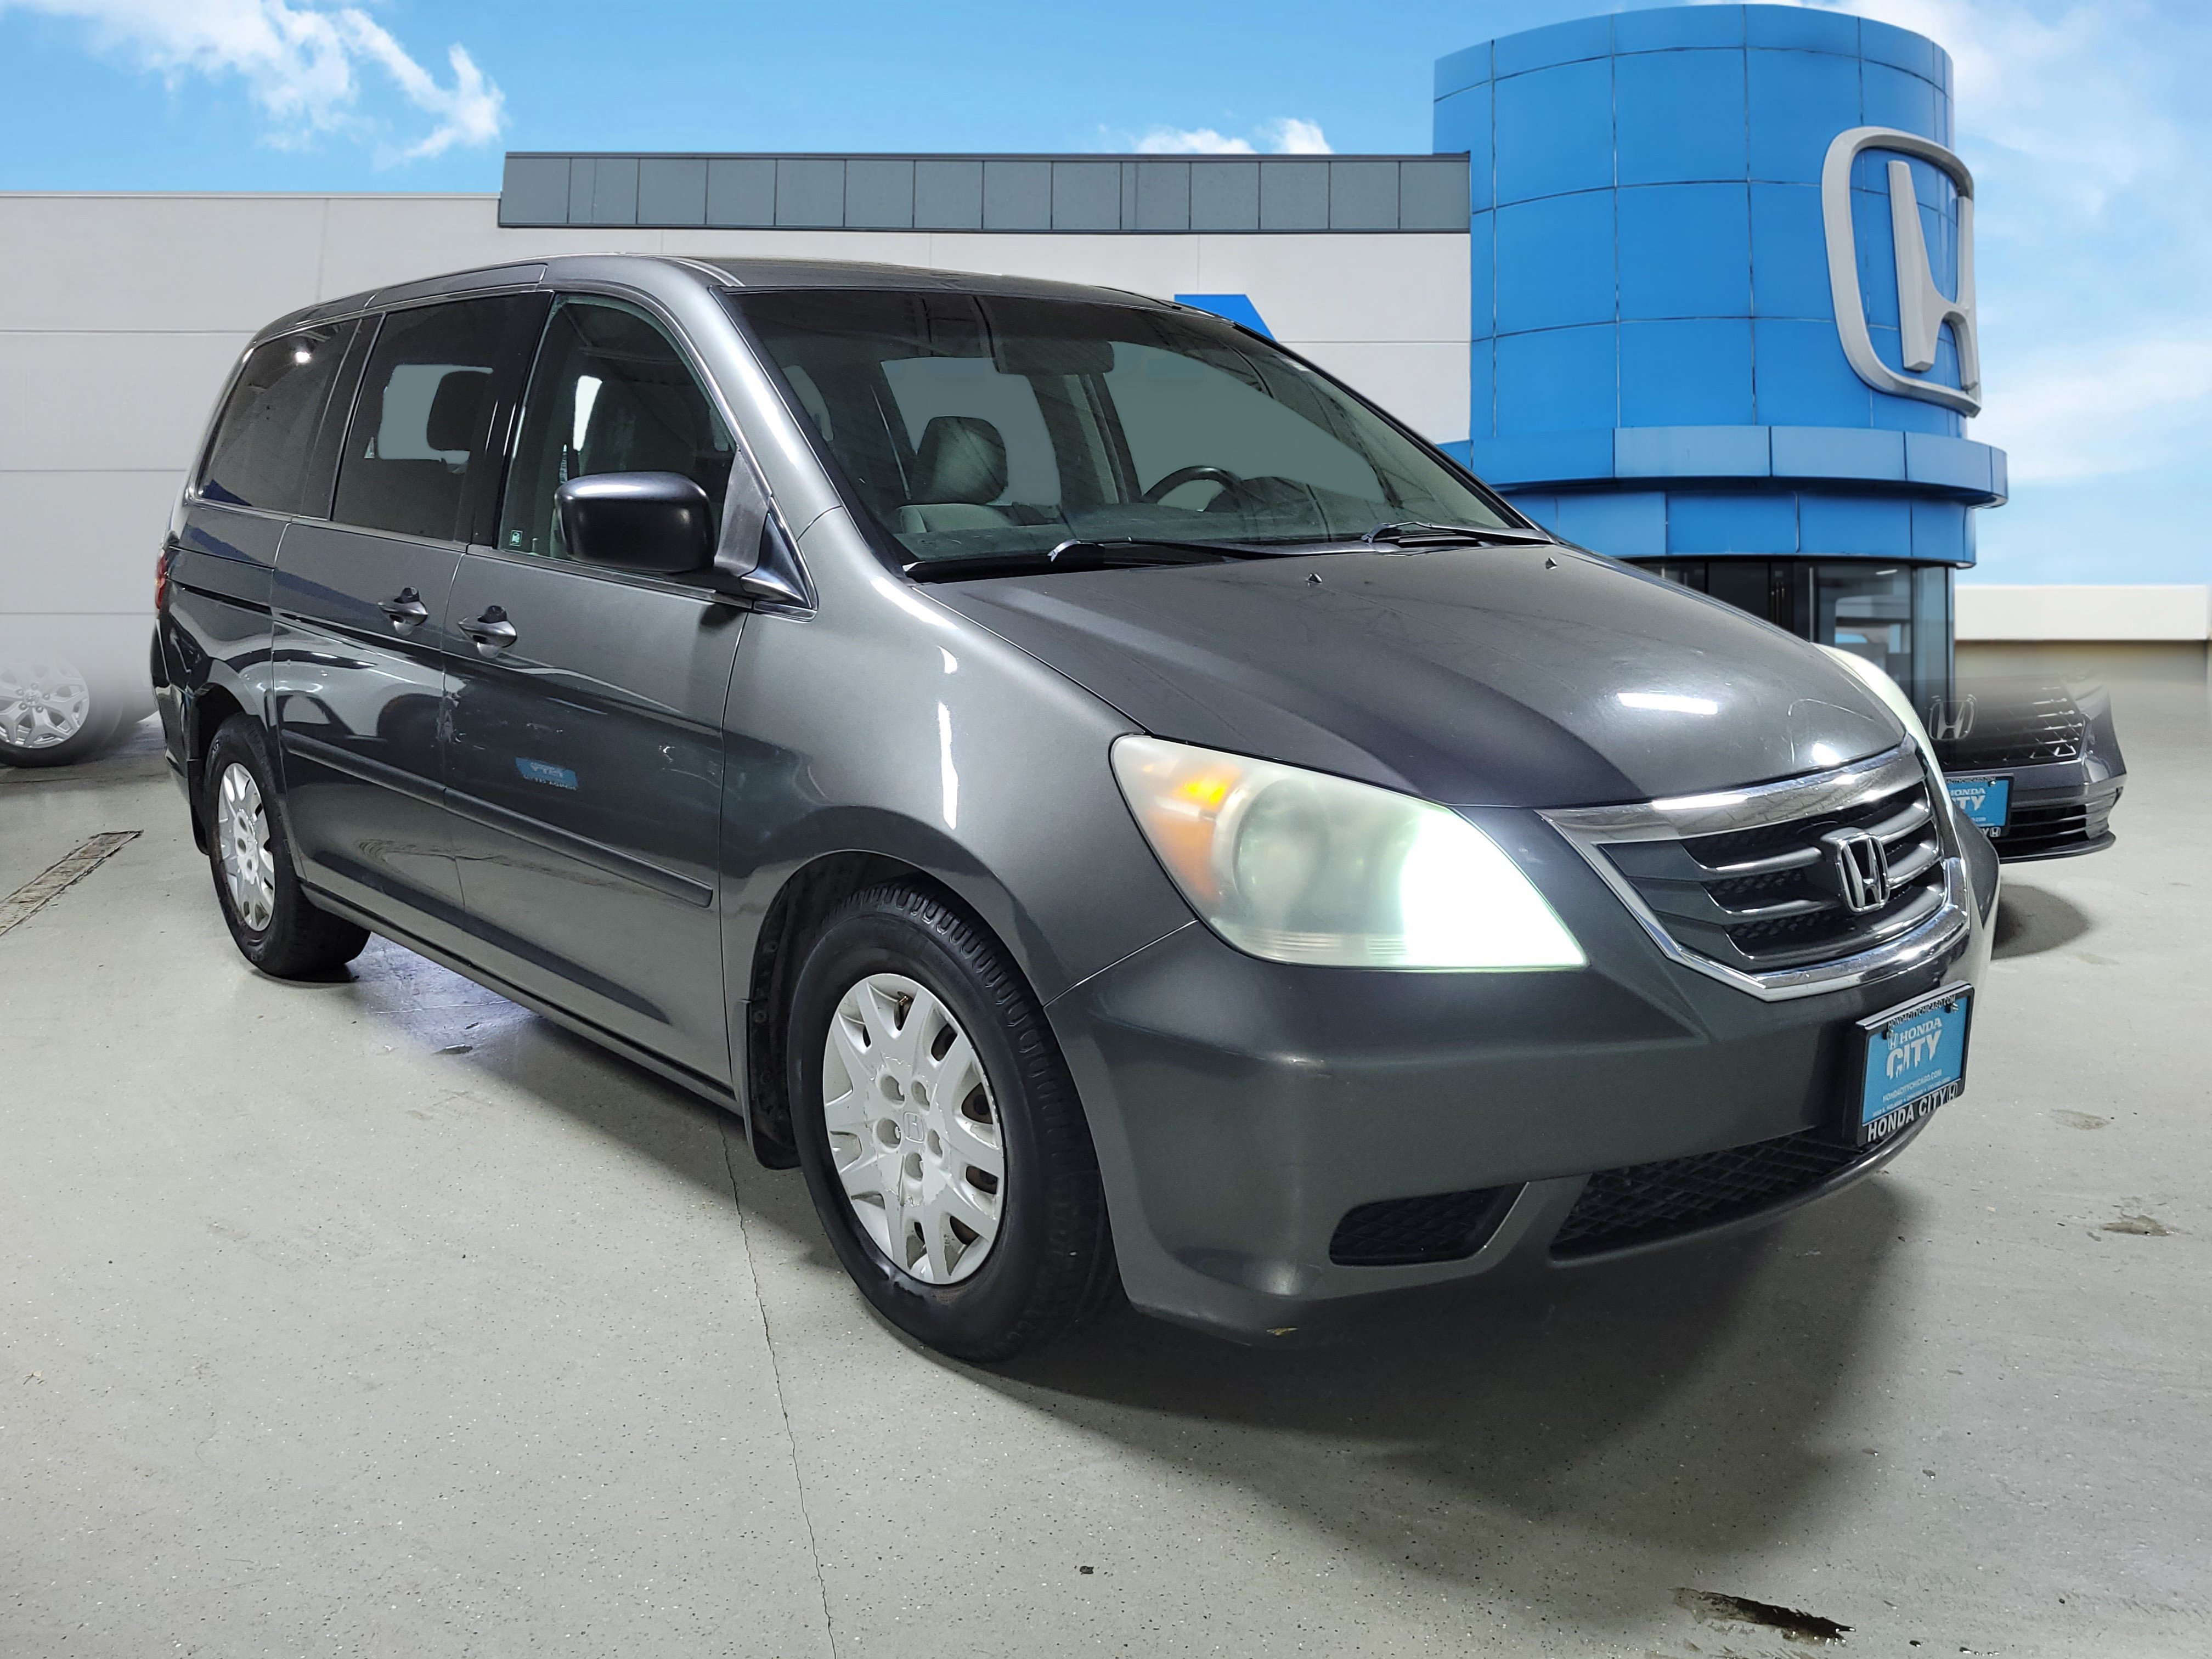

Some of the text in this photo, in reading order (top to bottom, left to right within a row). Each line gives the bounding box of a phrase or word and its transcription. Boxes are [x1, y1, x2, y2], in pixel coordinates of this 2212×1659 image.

[1951, 795, 1986, 810] TY
[1900, 1017, 1942, 1042] HONDA
[1886, 1029, 1942, 1080] CITY
[1867, 1087, 1947, 1142] HONDA CITY
